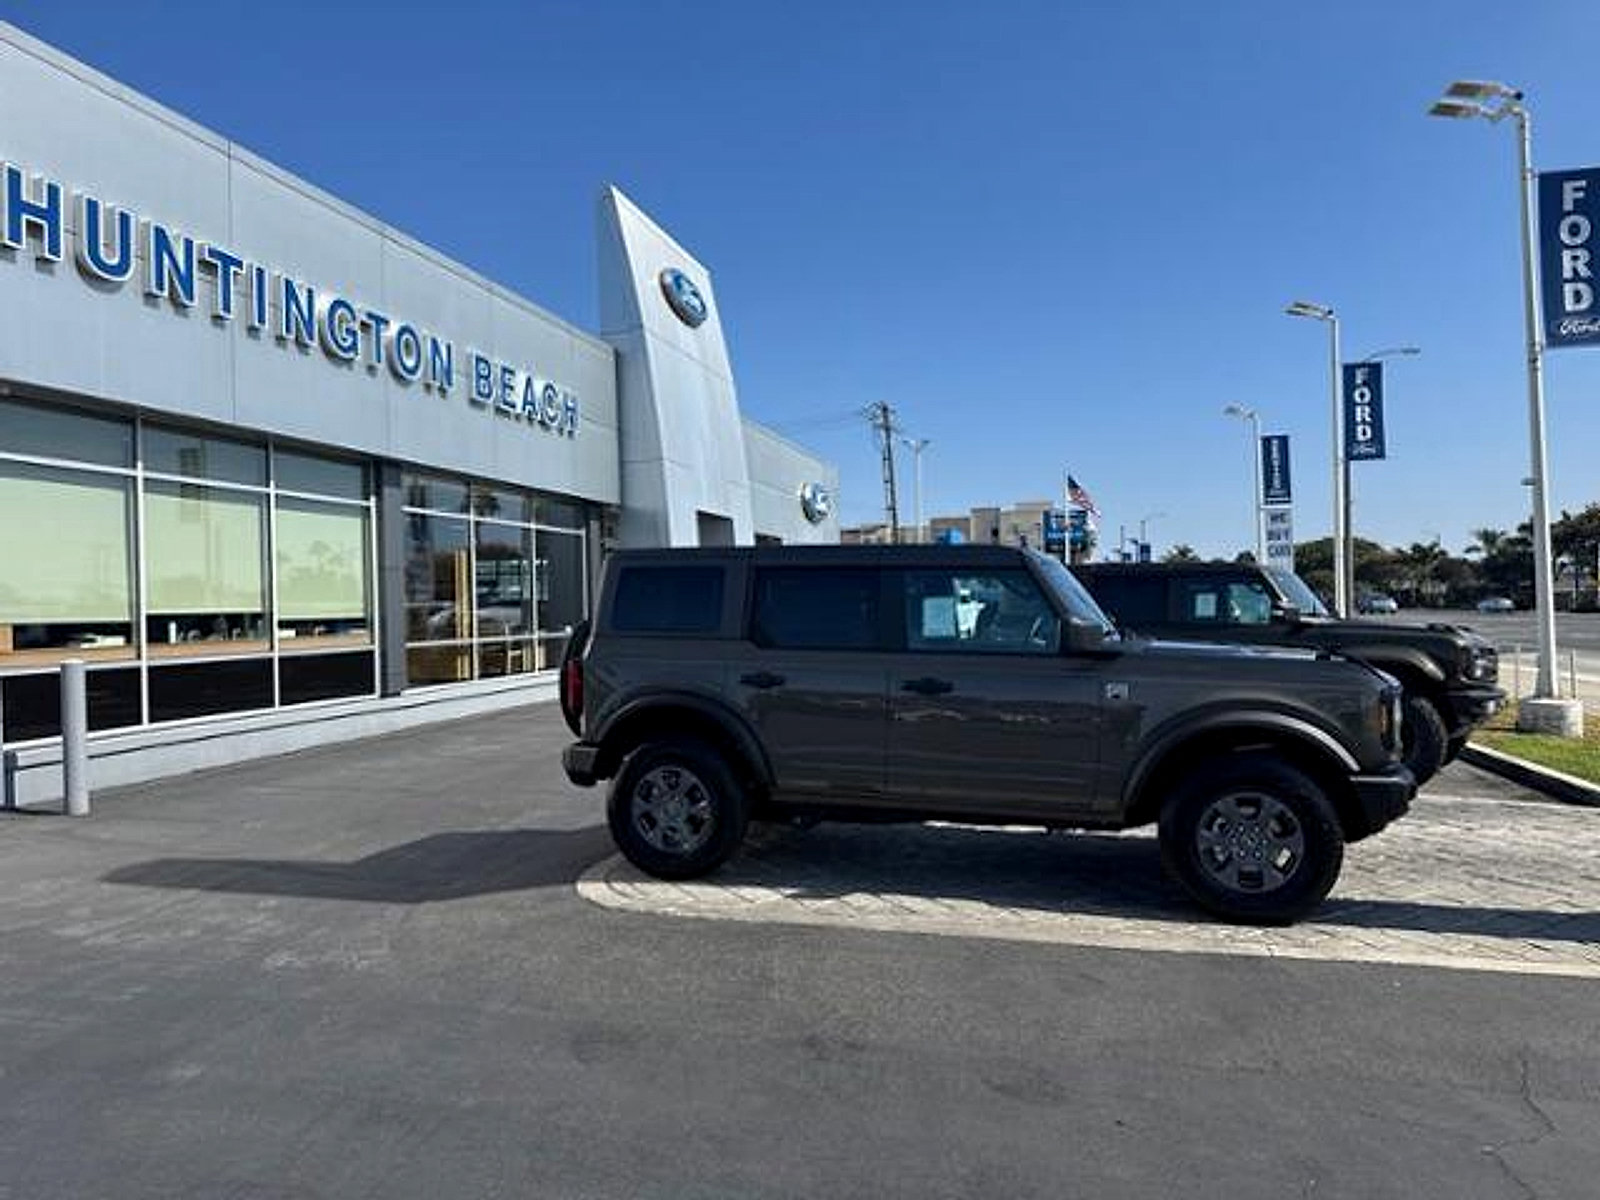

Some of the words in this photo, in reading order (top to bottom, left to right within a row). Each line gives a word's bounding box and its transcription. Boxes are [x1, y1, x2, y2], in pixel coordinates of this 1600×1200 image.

[4, 163, 455, 388] HUNTINGTON
[472, 350, 580, 431] BEACH
[1559, 180, 1593, 312] FORD
[1353, 371, 1372, 441] FORD
